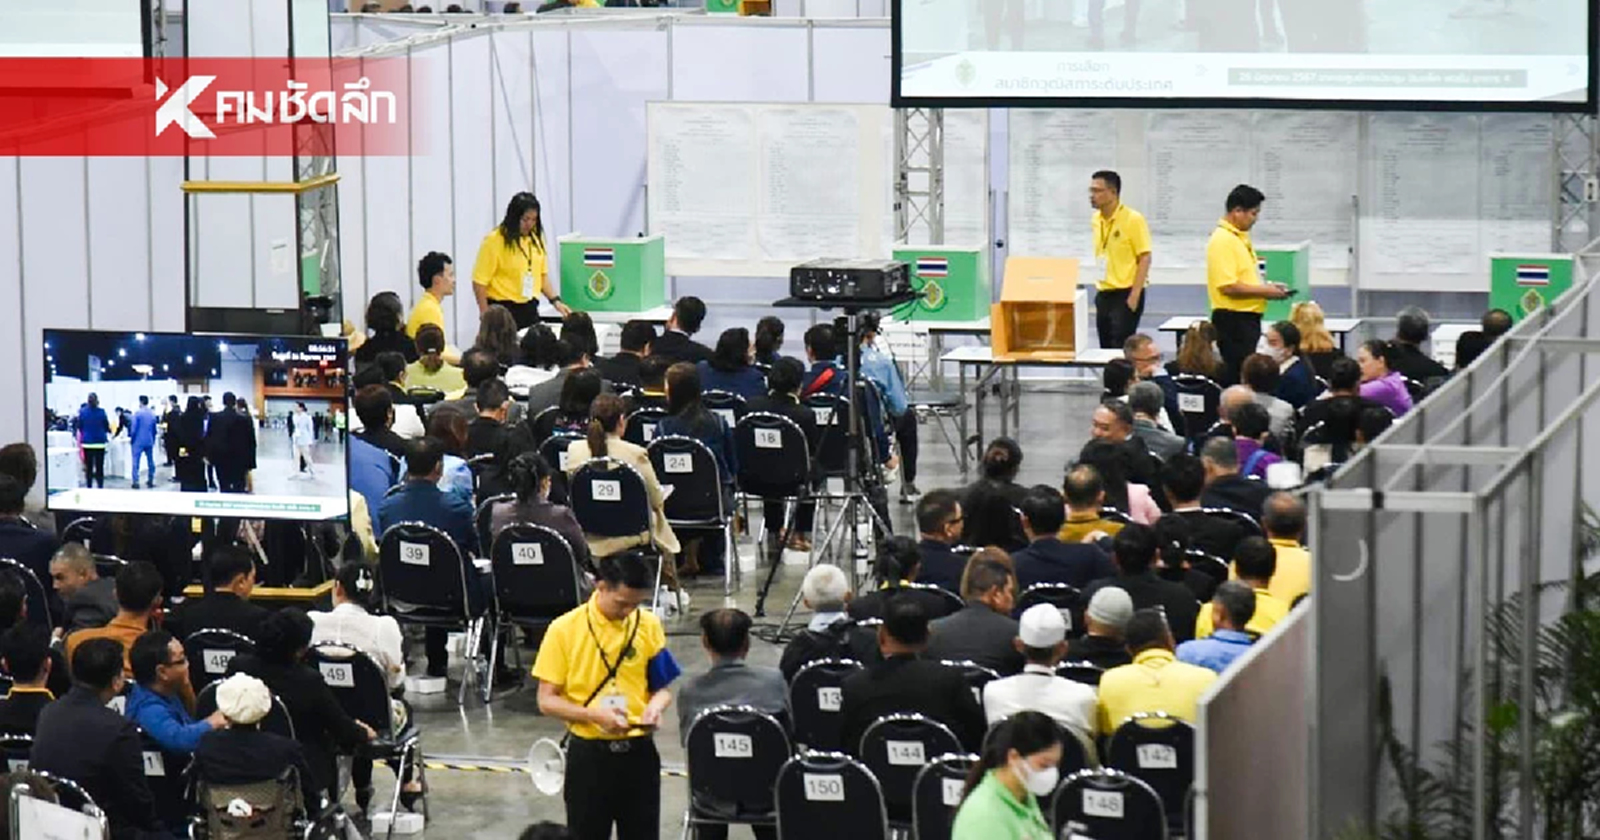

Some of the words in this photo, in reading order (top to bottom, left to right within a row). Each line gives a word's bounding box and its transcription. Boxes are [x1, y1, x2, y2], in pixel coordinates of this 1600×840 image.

[761, 432, 775, 444] 18
[670, 457, 686, 469] 24
[598, 484, 614, 496] 29
[405, 546, 423, 560] 39
[518, 546, 536, 560] 40
[211, 655, 228, 668] 48
[326, 667, 345, 680] 49
[822, 691, 841, 705] 13
[718, 738, 749, 752] 145
[890, 746, 921, 760] 144
[1141, 749, 1173, 763] 142
[809, 780, 840, 795] 150
